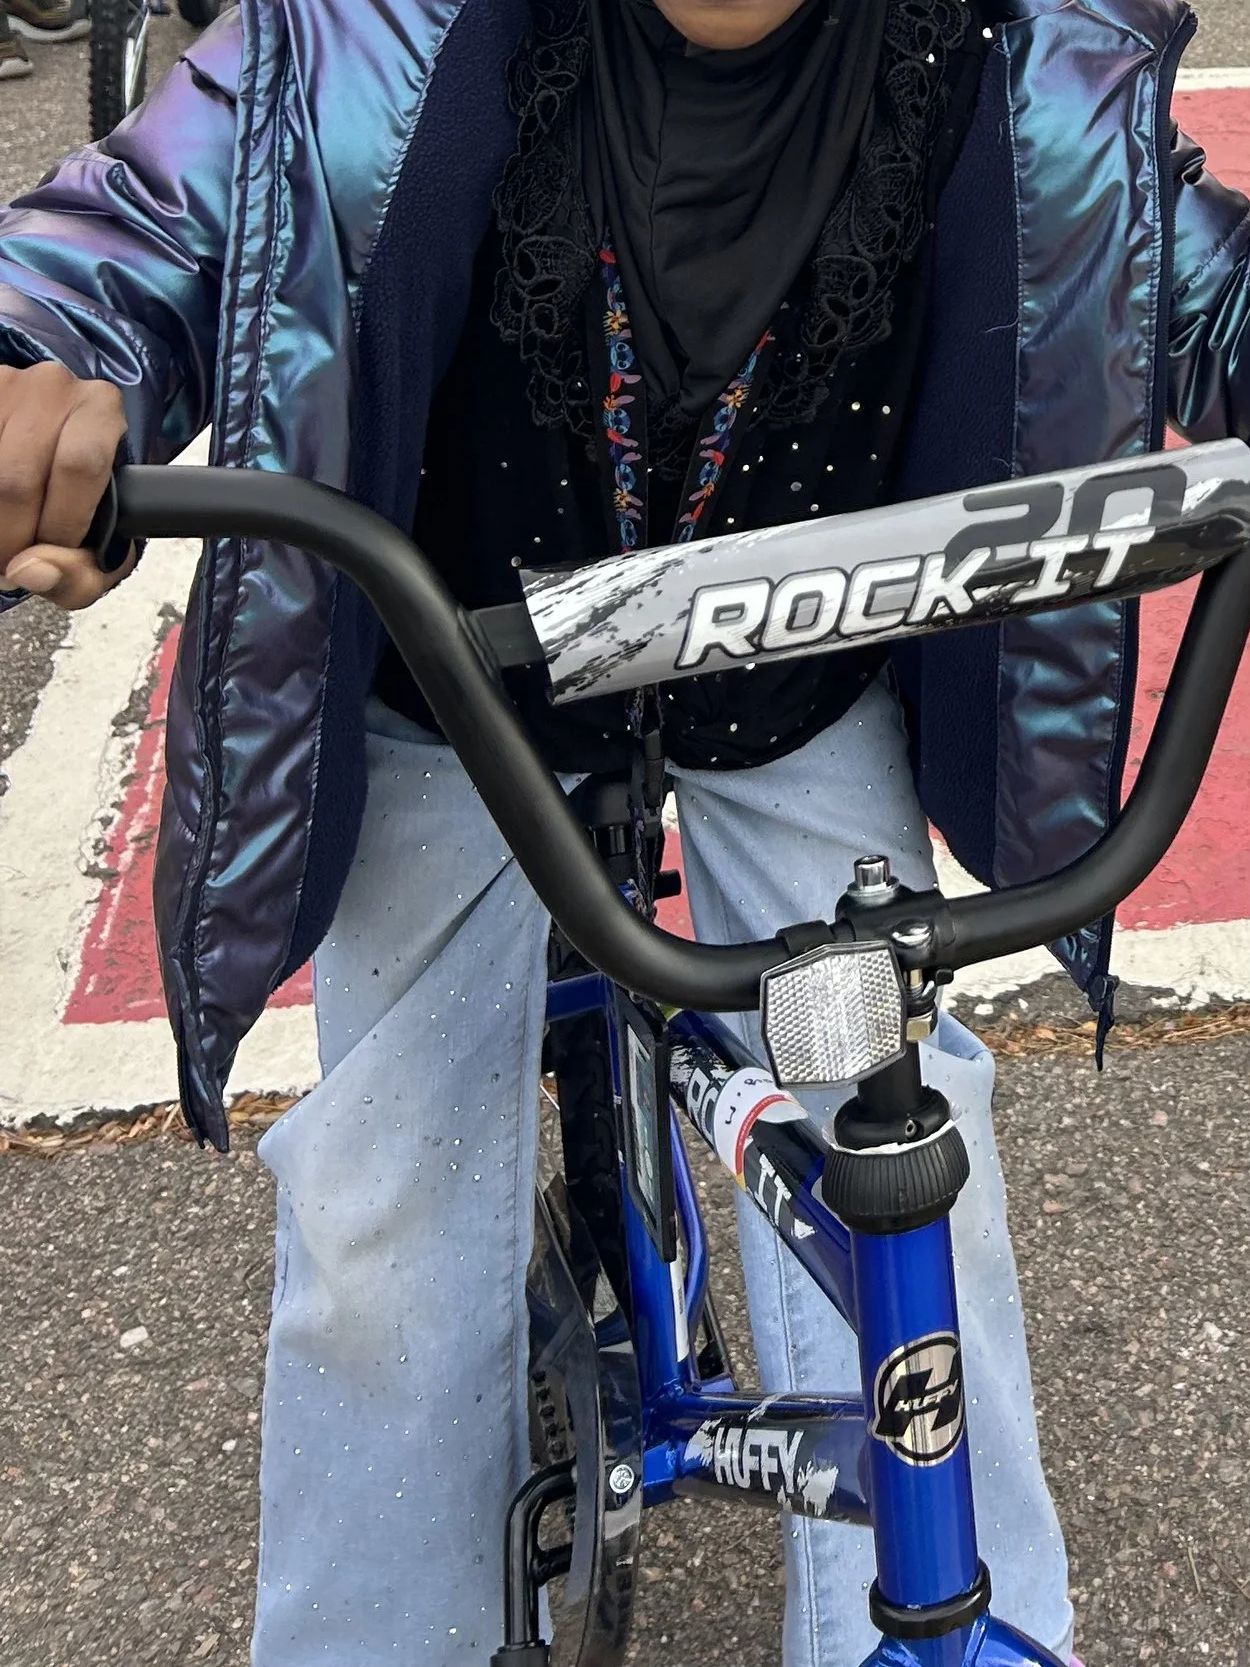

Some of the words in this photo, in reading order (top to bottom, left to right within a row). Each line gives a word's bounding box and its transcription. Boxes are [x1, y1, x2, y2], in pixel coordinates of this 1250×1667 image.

[675, 525, 1157, 670] ROCK-IT
[894, 1380, 959, 1413] HUFFY
[714, 1427, 804, 1495] HUFFY
